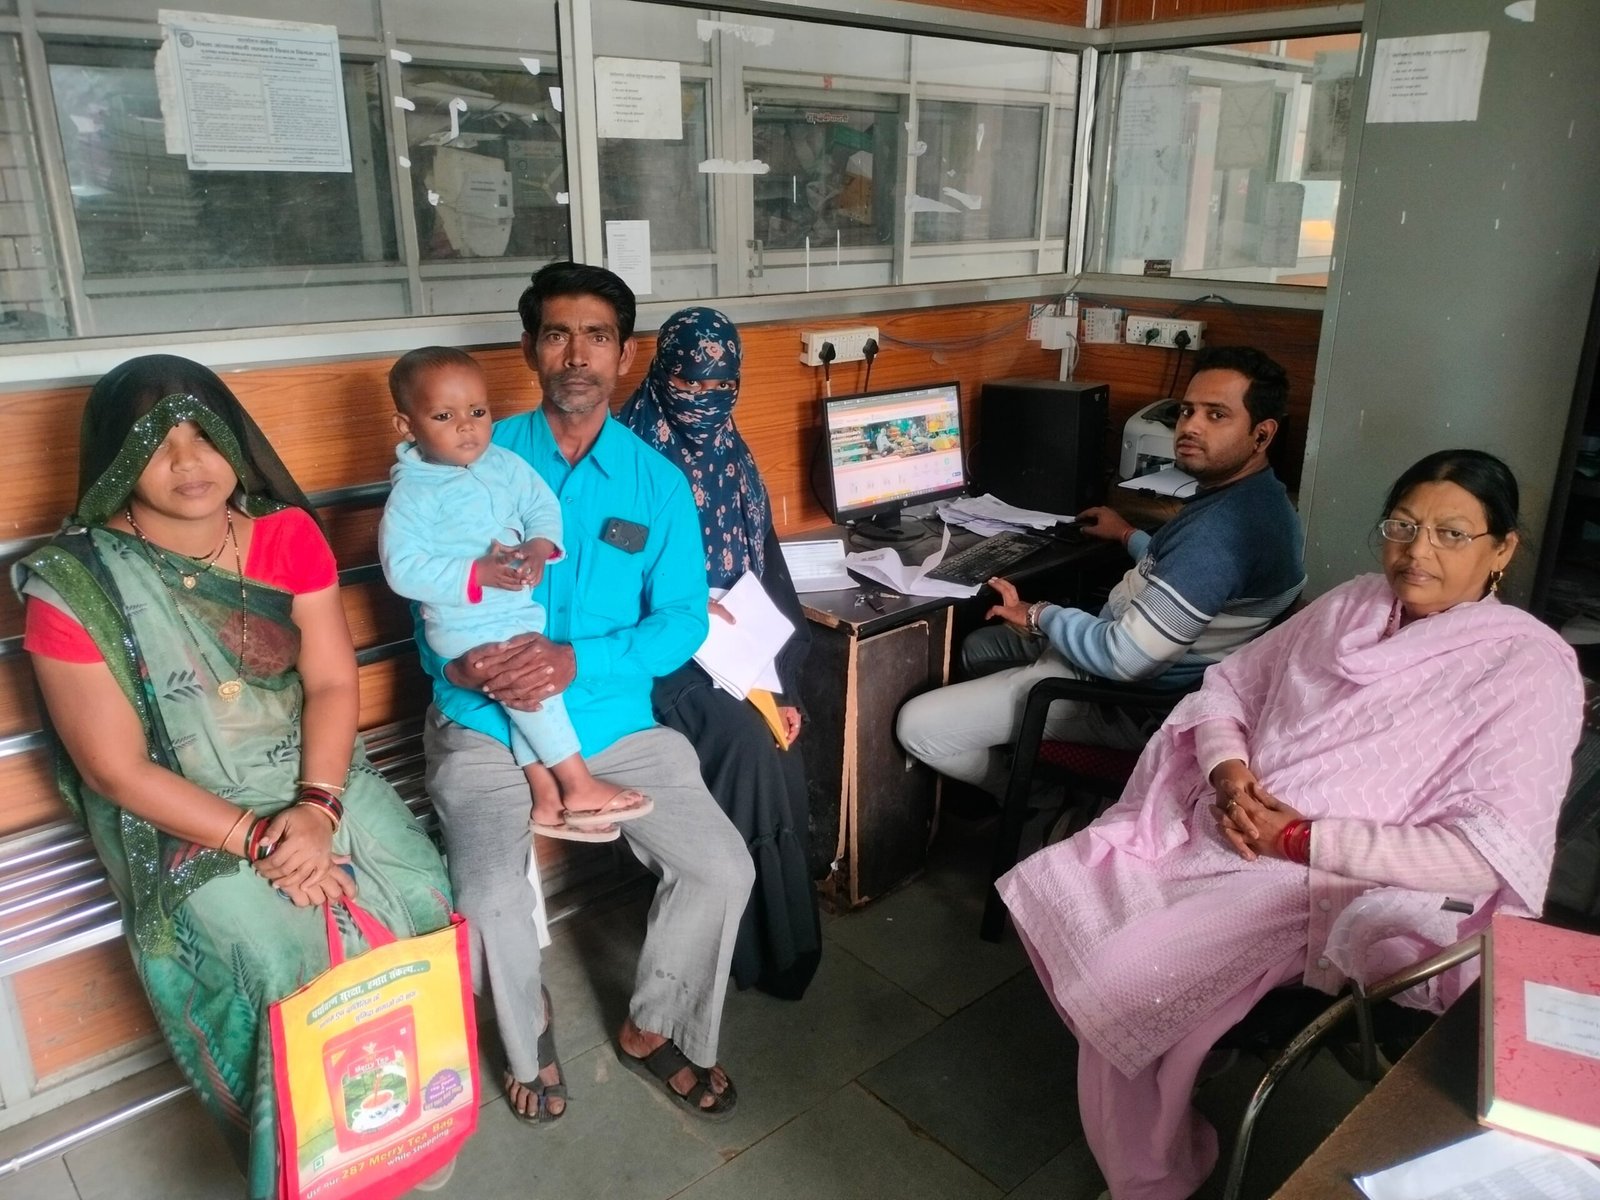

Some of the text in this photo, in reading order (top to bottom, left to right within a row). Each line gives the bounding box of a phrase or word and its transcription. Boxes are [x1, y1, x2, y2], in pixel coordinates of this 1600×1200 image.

[341, 1162, 366, 1179] 287
[368, 1145, 405, 1167] Merry
[407, 1132, 429, 1147] Tea
[432, 1117, 455, 1133] Bag
